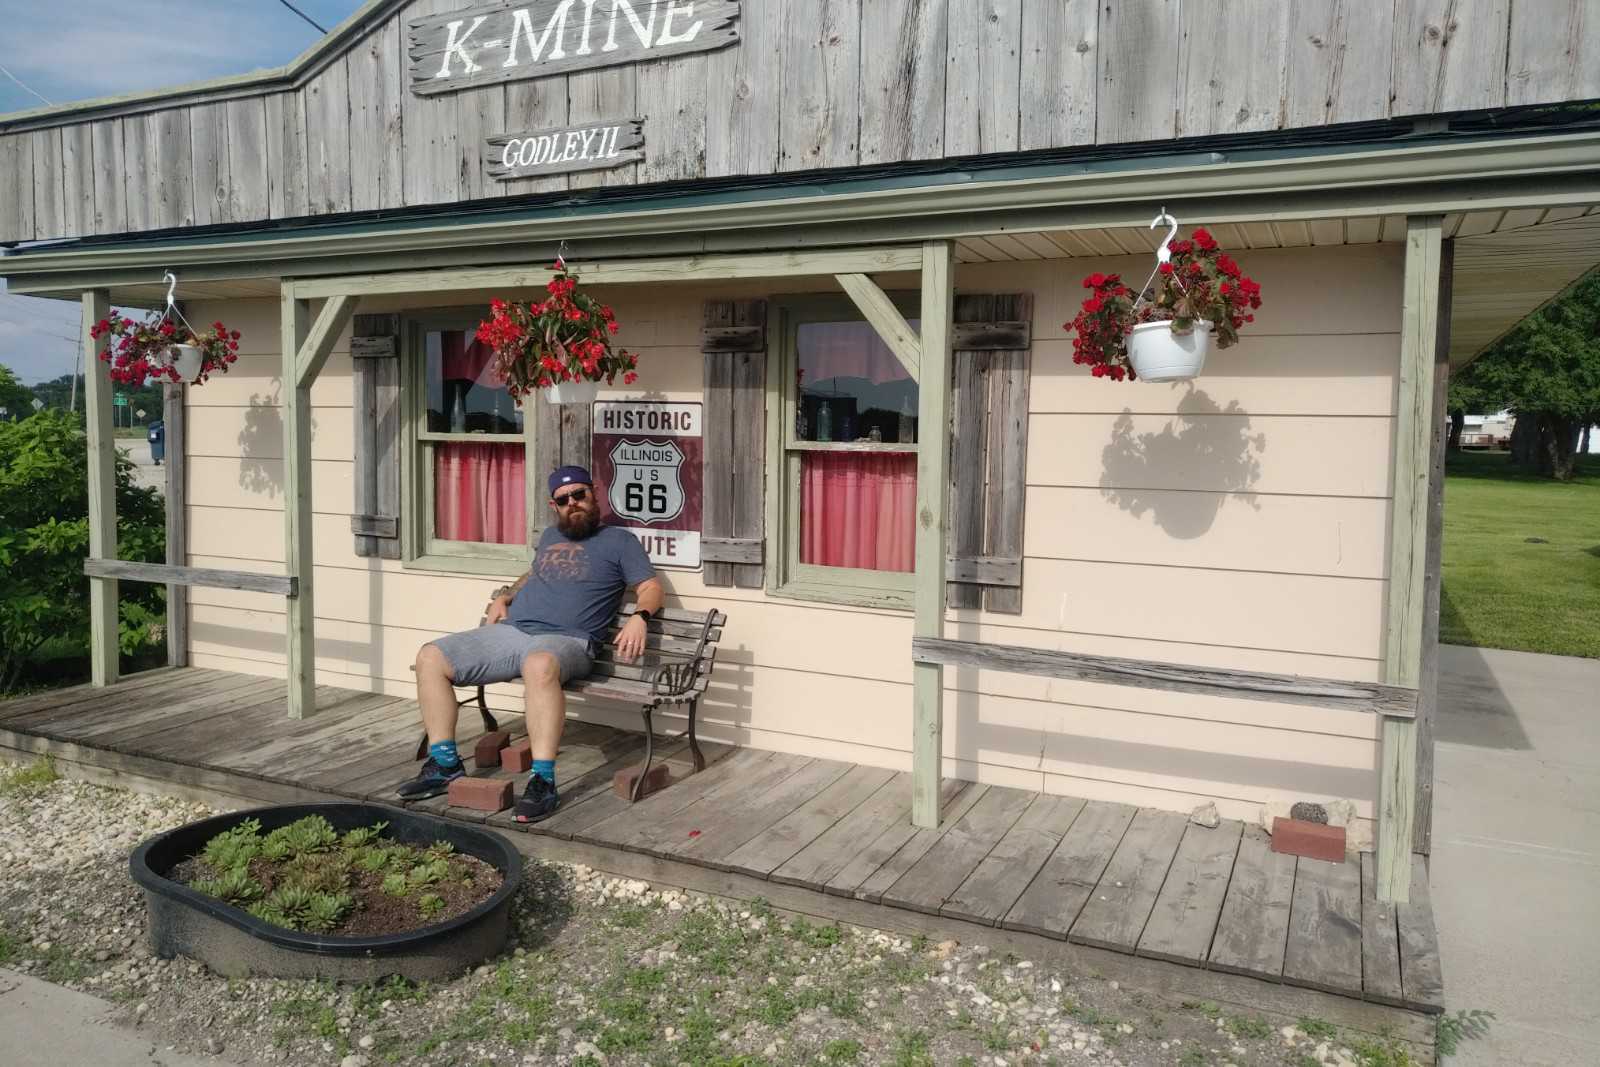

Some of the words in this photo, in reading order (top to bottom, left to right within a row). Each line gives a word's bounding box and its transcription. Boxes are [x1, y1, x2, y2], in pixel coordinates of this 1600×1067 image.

[435, 0, 704, 78] K-MINE
[596, 126, 621, 159] IL
[603, 409, 692, 431] HISTORIC
[620, 449, 673, 462] ILLINOIS
[625, 483, 667, 513] 66
[641, 535, 677, 556] UTE
